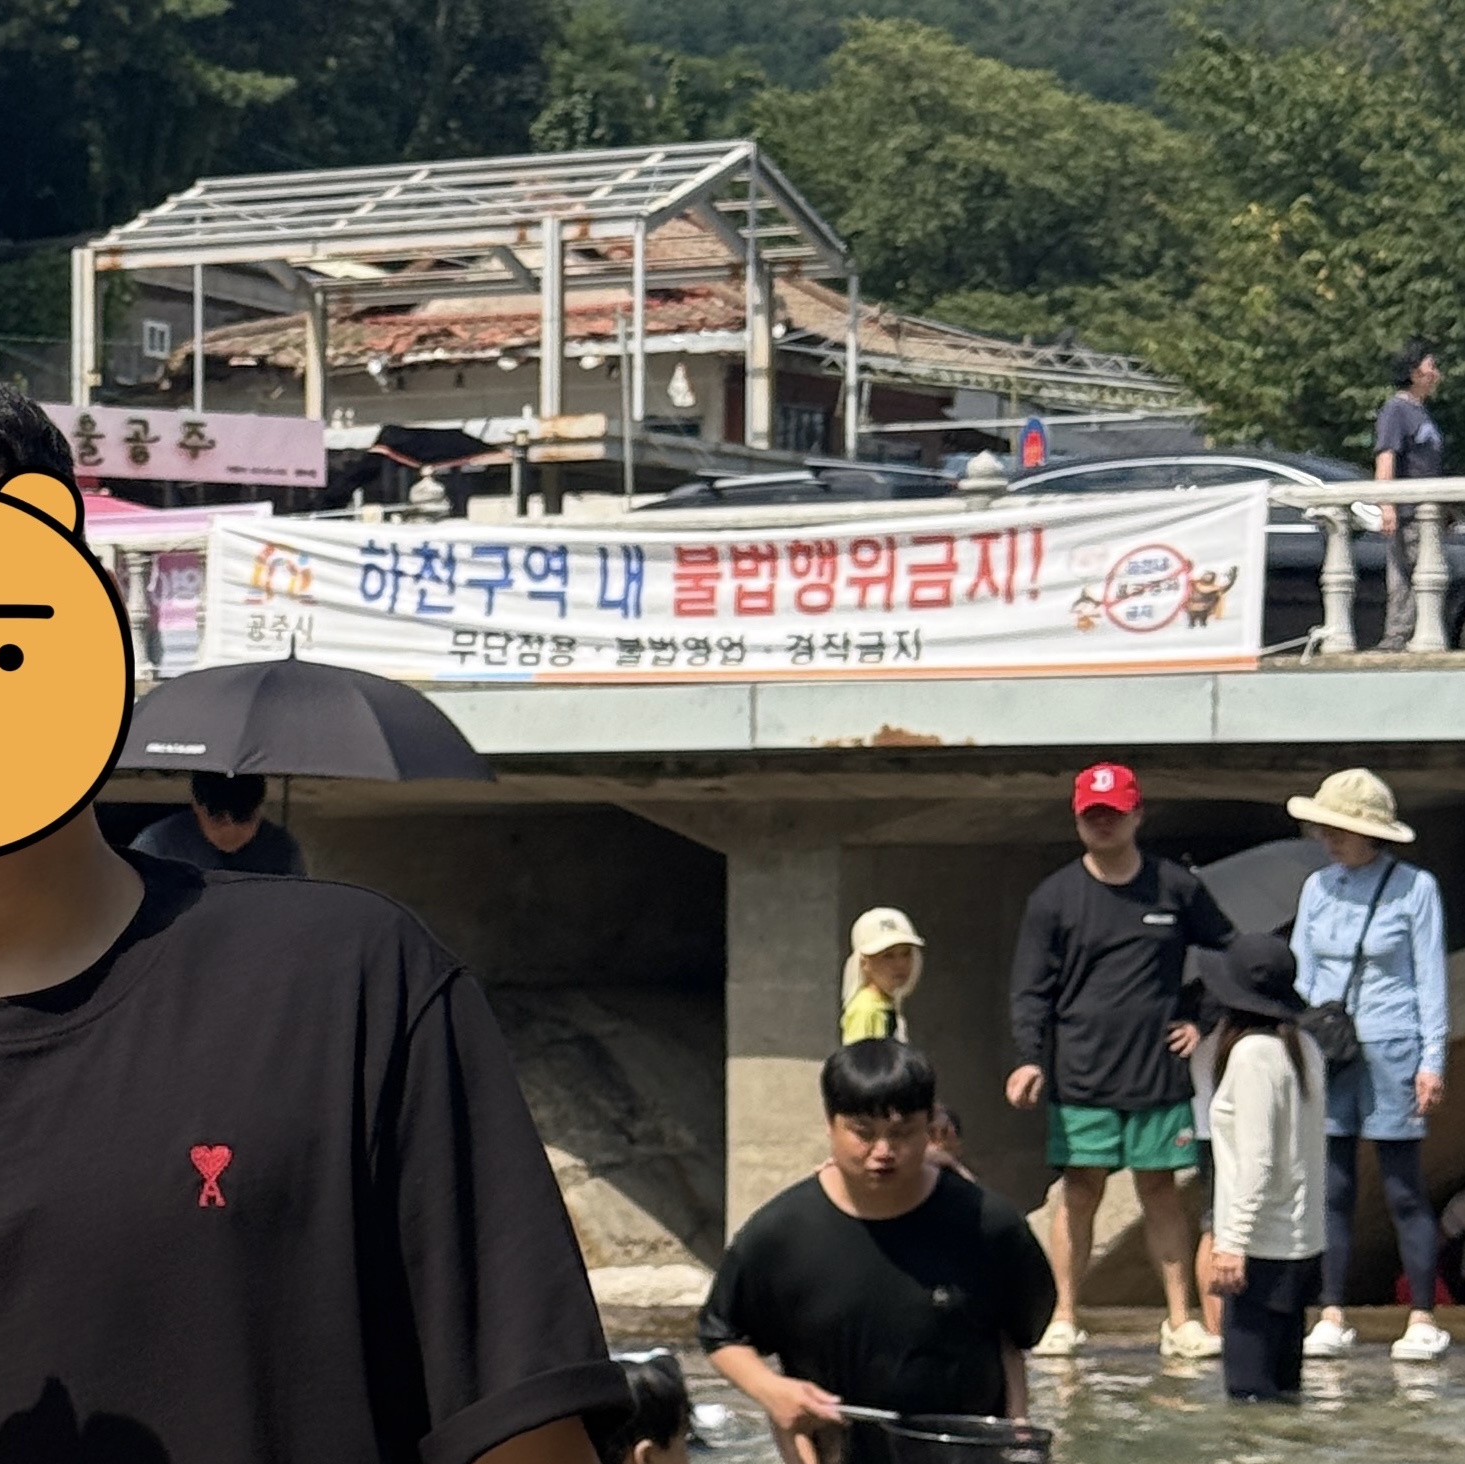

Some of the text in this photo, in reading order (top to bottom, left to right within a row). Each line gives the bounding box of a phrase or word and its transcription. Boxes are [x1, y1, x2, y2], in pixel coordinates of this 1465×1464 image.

[359, 526, 1045, 619] 하천구역 내 불법행위금지!
[245, 613, 315, 644] 공주시
[447, 629, 577, 667] 무단점용
[785, 627, 923, 665] 경작금지
